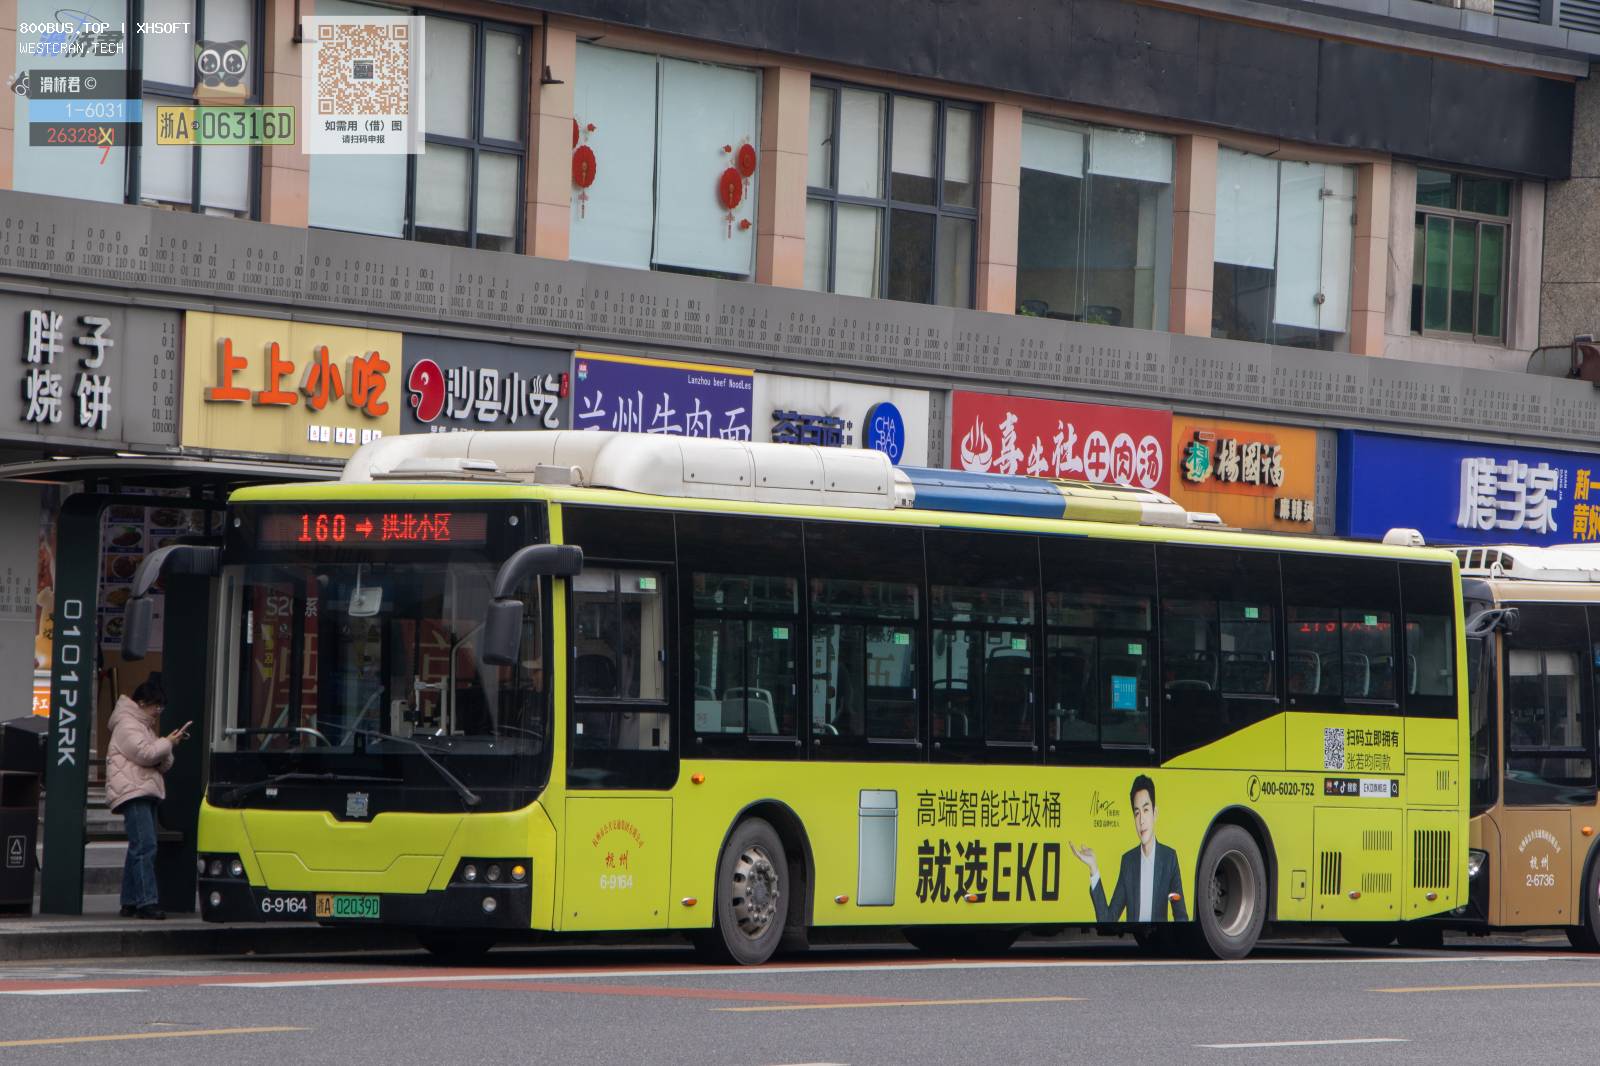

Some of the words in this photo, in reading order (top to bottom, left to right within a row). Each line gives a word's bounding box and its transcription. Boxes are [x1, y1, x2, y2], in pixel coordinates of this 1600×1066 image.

[24, 309, 114, 369] 胖子
[205, 337, 391, 417] 上上小吃
[23, 368, 112, 430] 烧饼
[447, 366, 560, 429] 沙县小吃
[875, 417, 896, 434] CHA
[880, 431, 895, 447] BAI
[299, 514, 346, 541] 160
[382, 513, 452, 541] 拱北小区
[1347, 729, 1399, 747] 扫码立即拥有
[1261, 781, 1315, 796] 400-6020-752
[917, 789, 1061, 828] 高端智能垃圾桶
[600, 874, 632, 889] 6-9164
[916, 839, 1061, 904] 就选EKO
[1526, 874, 1555, 887] 2-6736
[261, 897, 307, 913] 6-9164
